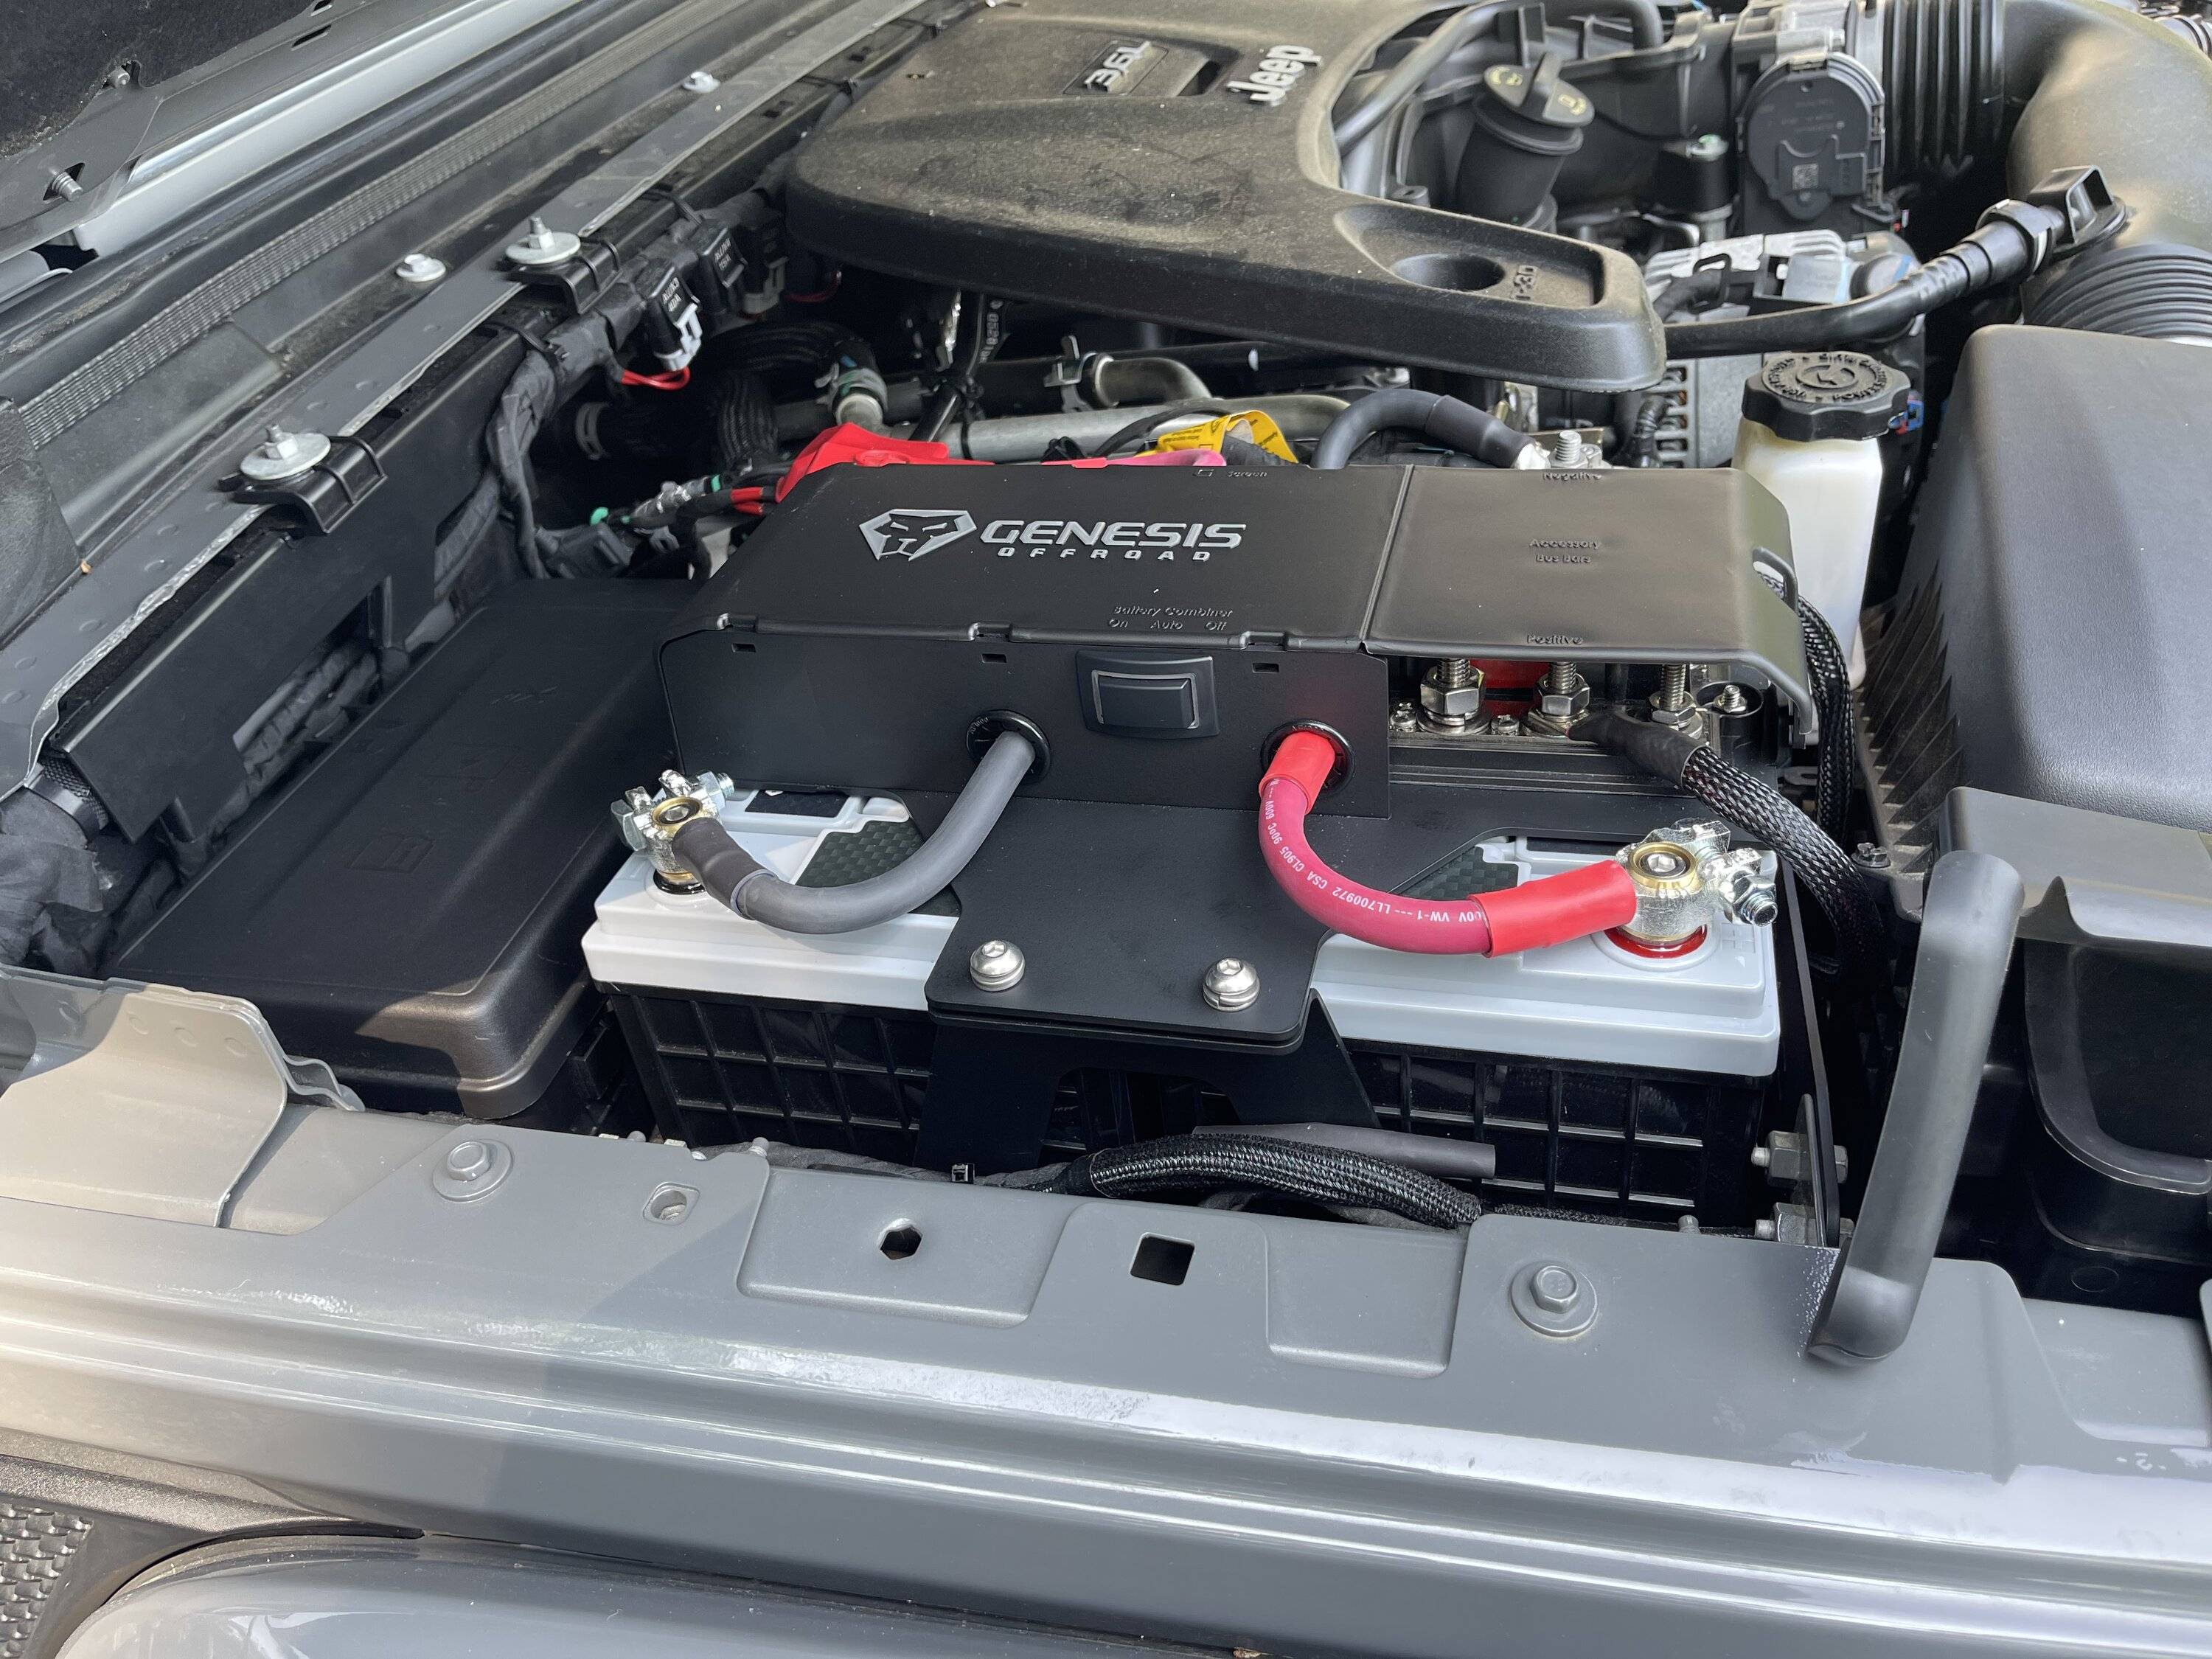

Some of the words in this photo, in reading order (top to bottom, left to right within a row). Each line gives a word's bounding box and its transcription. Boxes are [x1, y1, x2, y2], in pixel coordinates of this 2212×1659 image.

[1227, 45, 1321, 105] Jeep
[1543, 472, 1602, 481] Negative
[980, 520, 1247, 549] GENESIS
[1529, 539, 1601, 550] Accessory
[997, 547, 1211, 562] OFFROAD
[1535, 554, 1559, 563] Bus
[1114, 605, 1161, 617] Battery
[1165, 607, 1234, 617] Combiner
[1109, 618, 1129, 628] On
[1150, 620, 1183, 630] Auto
[1206, 621, 1228, 631] Off
[1526, 634, 1583, 645] Positive
[1265, 800, 1275, 820] 600V
[1279, 846, 1305, 872] CL905
[1307, 871, 1328, 889] CSA
[1332, 886, 1392, 914] LL700972
[1416, 909, 1450, 922] VW-1
